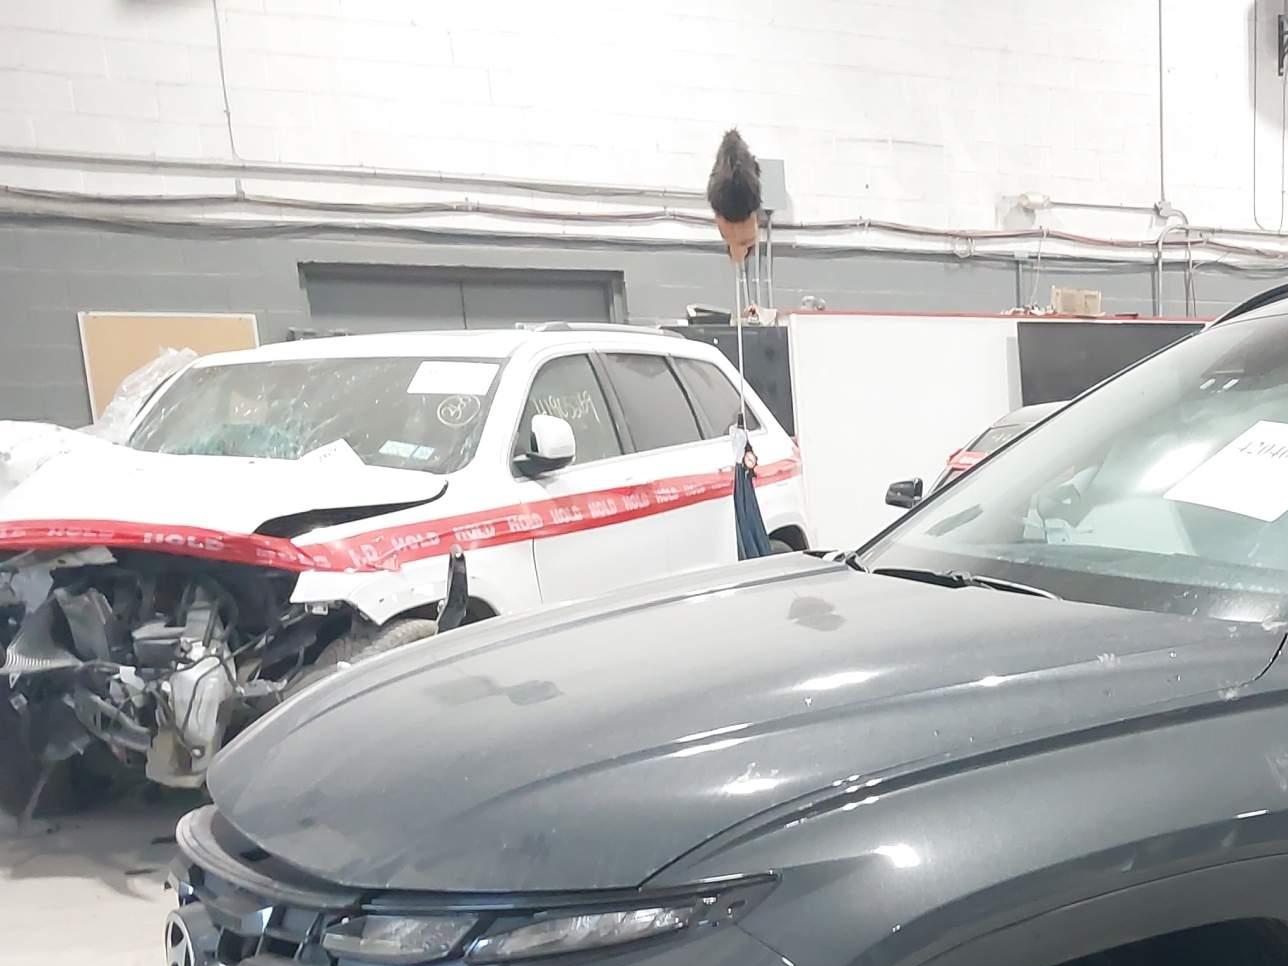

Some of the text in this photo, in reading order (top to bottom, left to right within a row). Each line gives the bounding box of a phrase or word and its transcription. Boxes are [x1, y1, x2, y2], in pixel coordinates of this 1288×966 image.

[550, 504, 584, 525] HOLD
[588, 498, 618, 519] HOLD
[622, 490, 651, 511] HOLD
